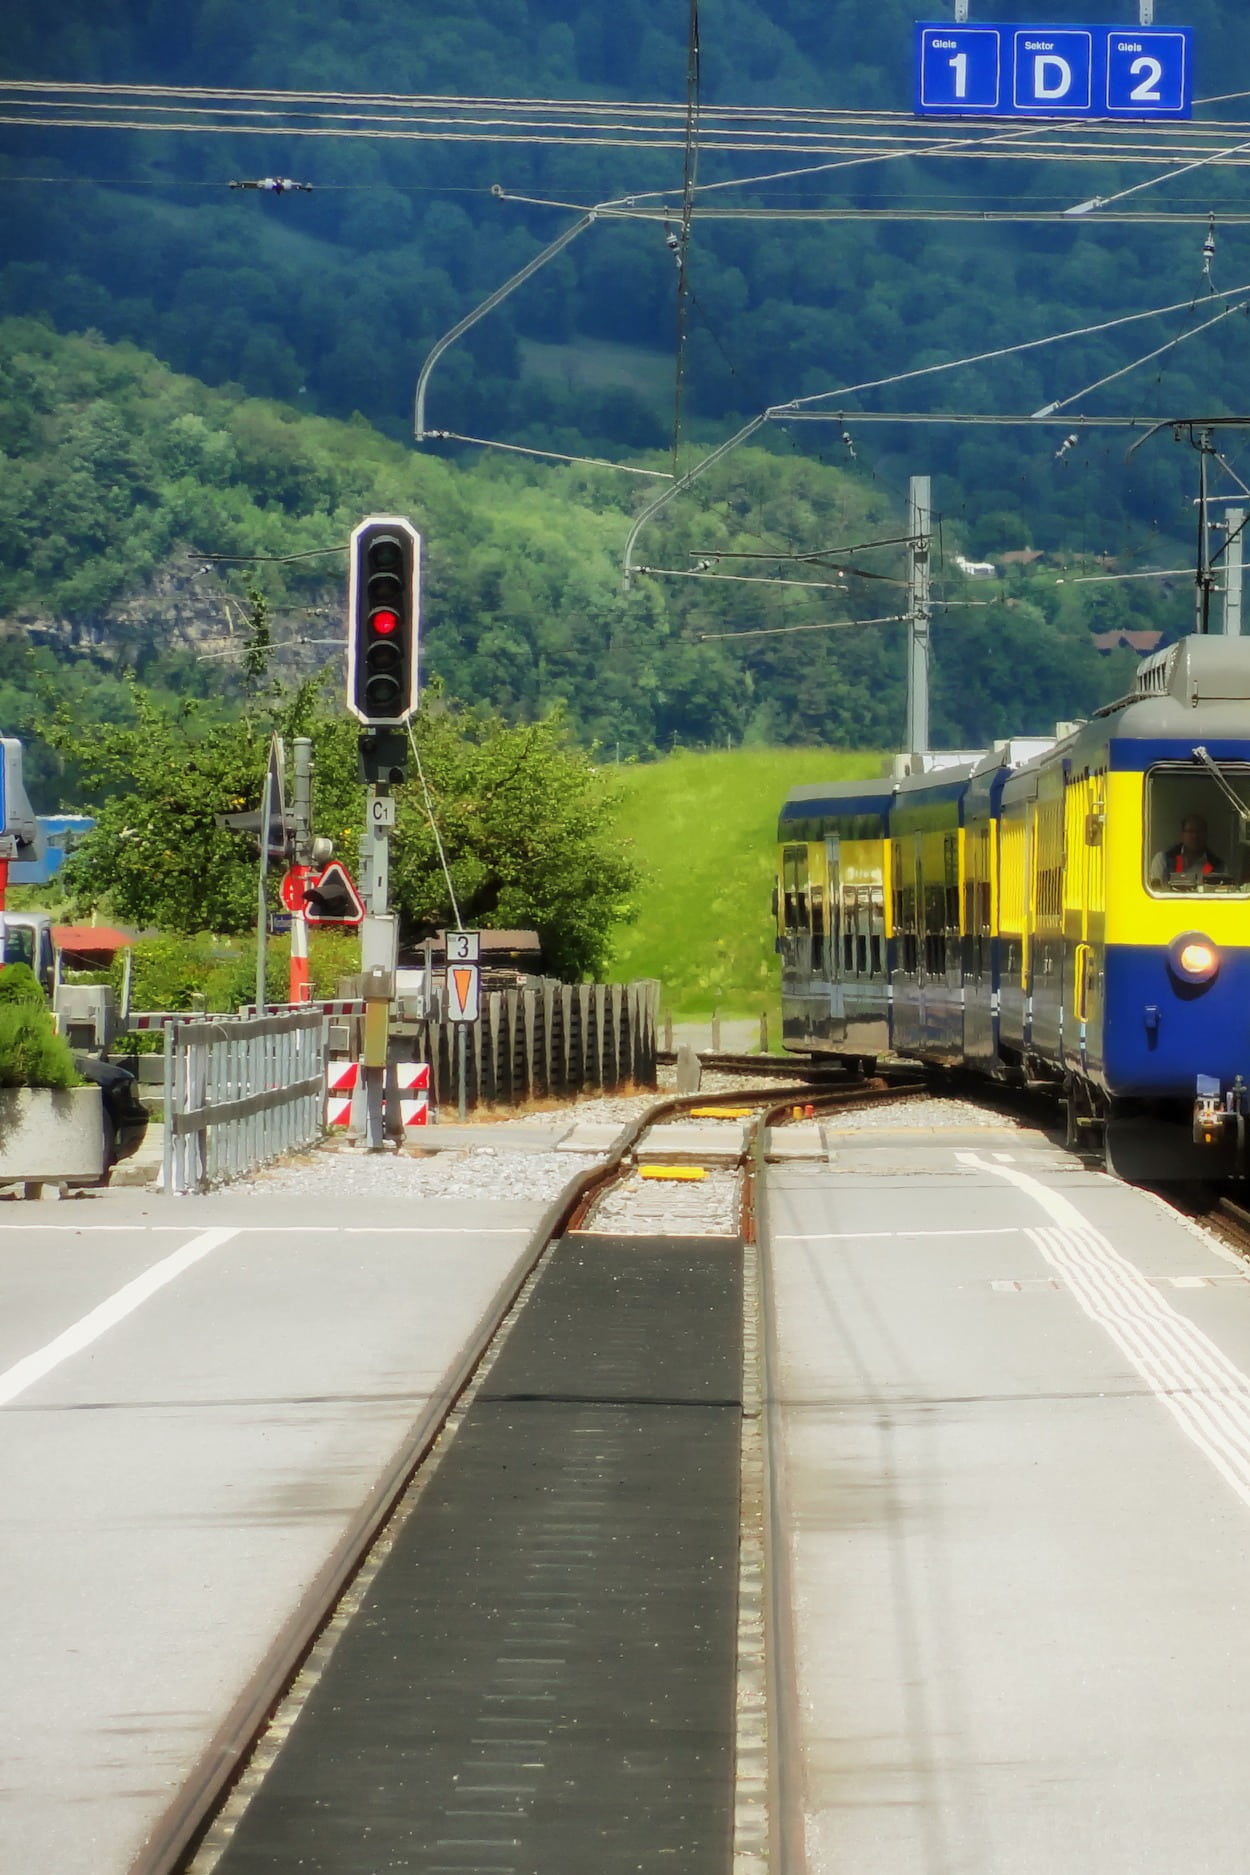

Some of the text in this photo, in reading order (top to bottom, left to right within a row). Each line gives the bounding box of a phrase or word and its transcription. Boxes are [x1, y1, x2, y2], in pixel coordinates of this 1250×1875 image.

[932, 39, 957, 49] Gleis
[1024, 41, 1054, 51] Sektor
[1117, 42, 1142, 52] Gleis
[949, 53, 967, 97] 1
[1034, 55, 1071, 98] D
[1130, 57, 1162, 100] 2
[372, 801, 388, 820] C1
[457, 936, 469, 958] 3
